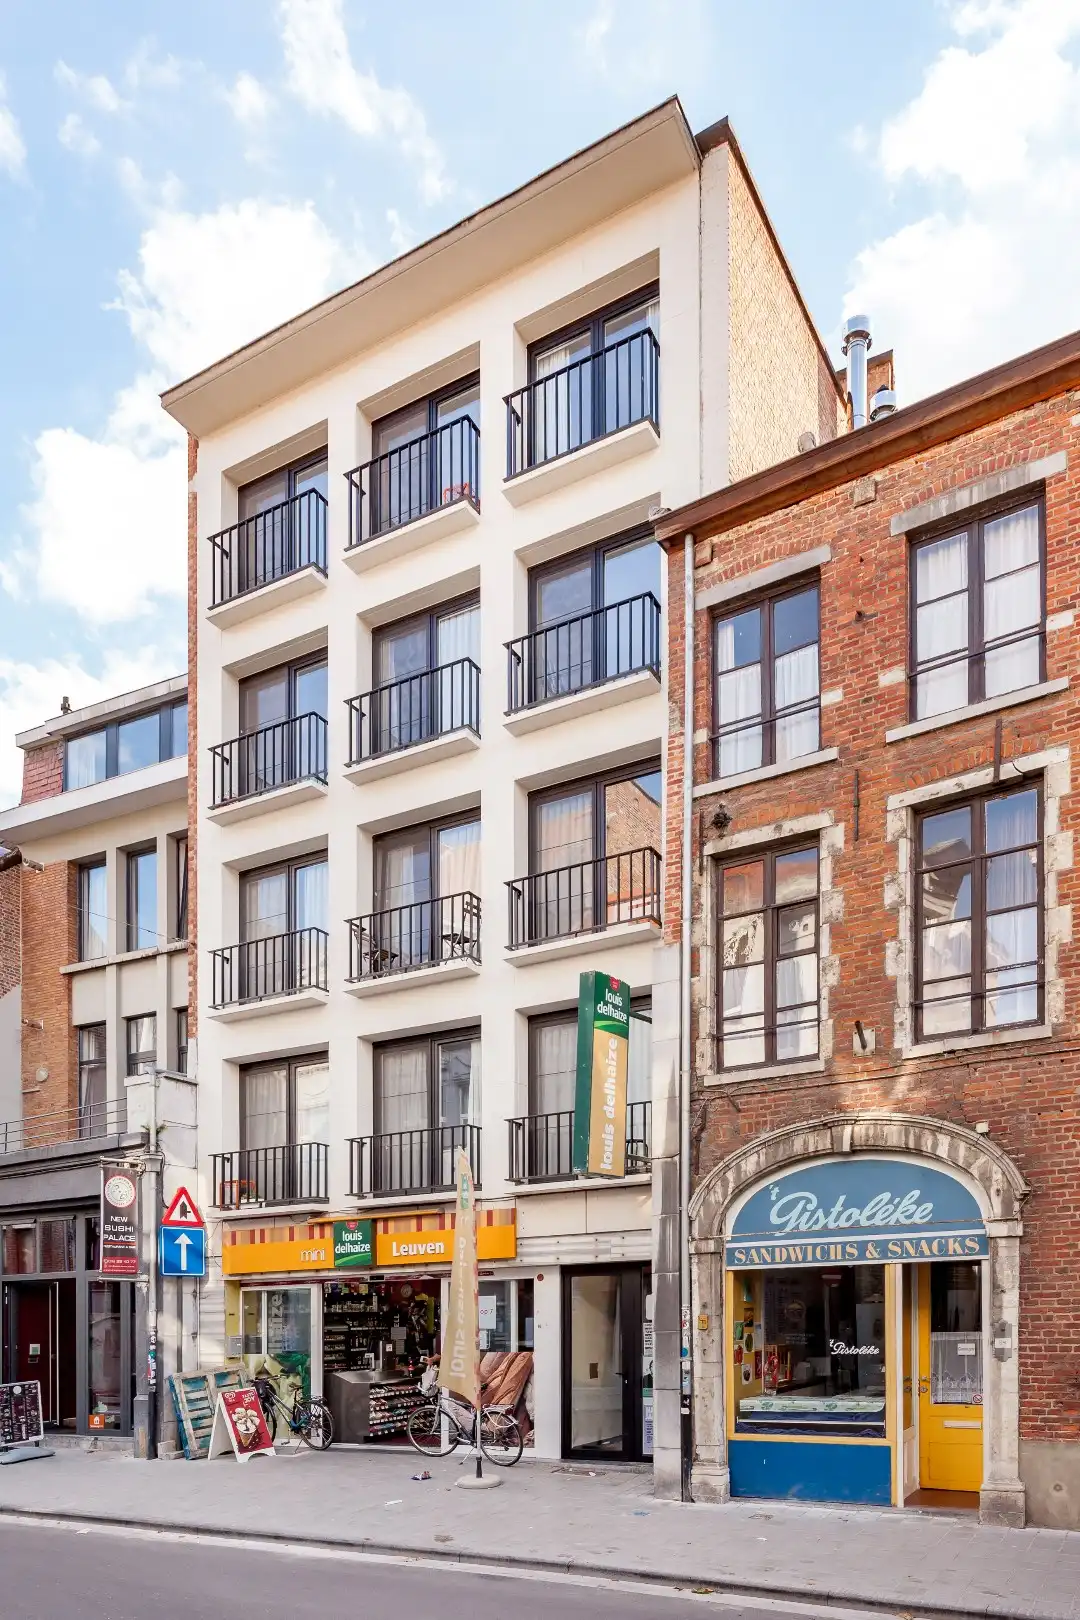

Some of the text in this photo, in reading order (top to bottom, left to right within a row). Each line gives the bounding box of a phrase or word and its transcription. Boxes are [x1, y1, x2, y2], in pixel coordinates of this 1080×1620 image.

[605, 988, 622, 1006] louis
[597, 1001, 627, 1022] delhaize
[601, 1038, 618, 1169] louis delhaize
[342, 1230, 362, 1241] louis
[300, 1248, 325, 1262] mini
[335, 1242, 371, 1254] delhaize
[392, 1242, 444, 1256] Leuven
[866, 1242, 880, 1258] &
[888, 1237, 980, 1258] SNACKS
